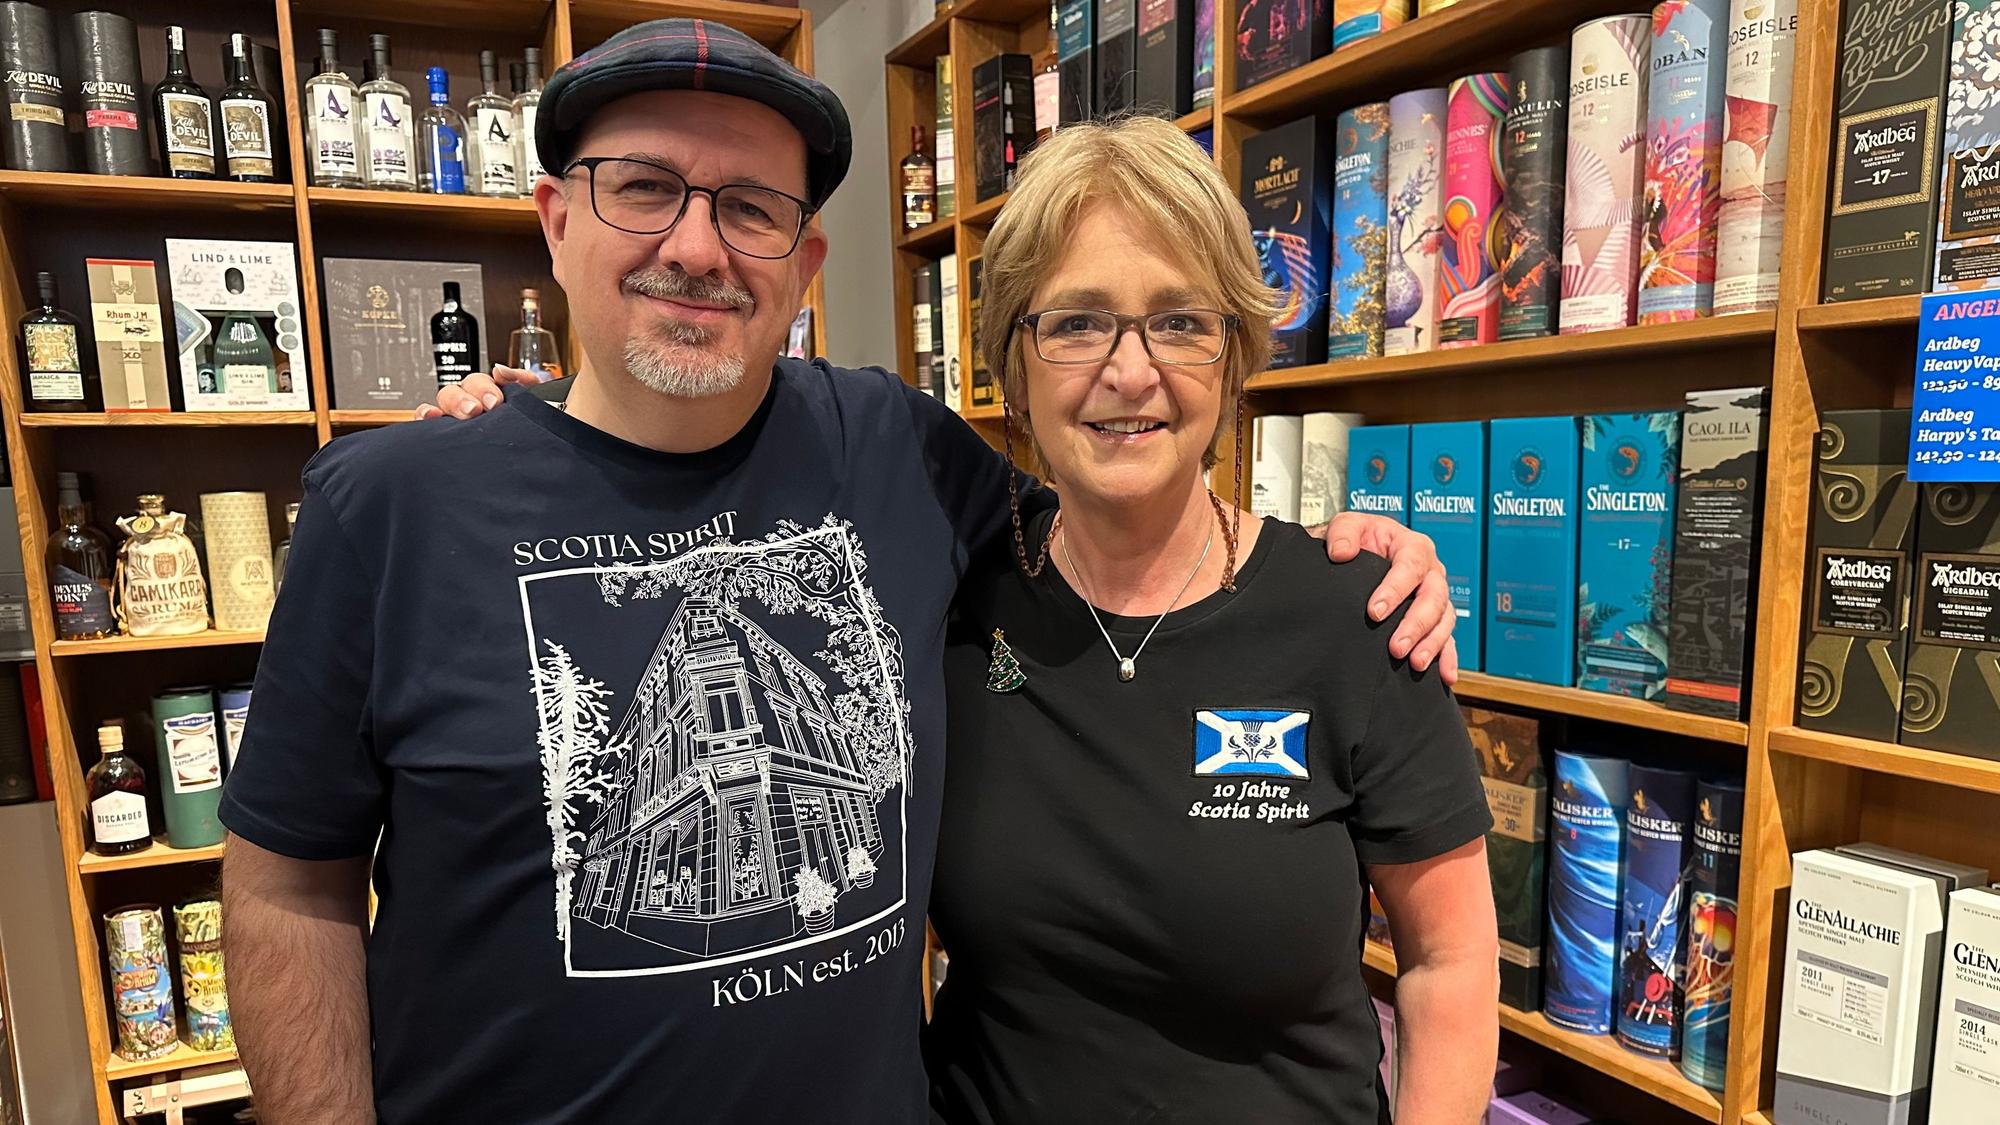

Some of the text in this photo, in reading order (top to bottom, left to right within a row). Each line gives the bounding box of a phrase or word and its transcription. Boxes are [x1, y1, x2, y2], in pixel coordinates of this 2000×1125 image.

[1653, 47, 1707, 71] OBAN
[1745, 51, 1759, 67] 12
[4, 70, 28, 84] Kill
[28, 72, 62, 89] DEVIL
[80, 81, 135, 95] Kill DEVIL
[1583, 103, 1594, 116] 12
[172, 116, 194, 127] Kill
[228, 122, 247, 133] Kill
[176, 126, 208, 139] DEVIL
[230, 131, 262, 142] DEVIL
[1515, 130, 1525, 144] 12
[1254, 168, 1301, 193] MORTLACH
[1872, 169, 1891, 185] 17
[1967, 214, 1991, 223] SCOTCH
[192, 253, 224, 263] LIND
[240, 255, 272, 264] LIME
[106, 310, 131, 319] Rhum
[361, 310, 398, 319] KOPKE
[1924, 336, 1981, 352] Ardbeg
[1918, 408, 1974, 424] Ardbeg
[1688, 421, 1751, 437] CAOL ILA
[1917, 427, 1977, 445] Harpy's
[1350, 490, 1403, 512] SINGLETON
[1414, 491, 1476, 514] SINGLETON
[1493, 493, 1566, 518] SINGLETON
[1587, 487, 1668, 513] SINGLETON
[513, 510, 738, 566] SCOTIA SPIRIT
[1618, 538, 1630, 550] 17
[1456, 586, 1470, 595] OLD
[1830, 579, 1884, 589] CORRYVRECKAN
[1943, 586, 1989, 597] UIGEADAIL
[55, 592, 88, 602] POINT
[1496, 592, 1511, 613] 18
[152, 601, 191, 614] RUM
[1212, 780, 1290, 801] 10 Jahre
[1188, 799, 1310, 823] Scotia Spirit
[1553, 797, 1613, 818] TALISKER
[97, 811, 142, 824] DISCARDED
[1703, 853, 1713, 868] 11
[1798, 920, 1865, 945] SPEYSIDE SINGLE MALT
[1798, 926, 1847, 946] SCOTCH WHISKY
[1972, 945, 1984, 953] THE
[712, 917, 906, 1008] KÖLN est. 2013
[1801, 966, 1822, 982] 2011
[1956, 965, 1987, 980] SPEYSIDE
[1956, 973, 1984, 987] SCOTCH
[1801, 977, 1834, 992] SINGLE CASK
[1960, 1018, 1986, 1036] 2014
[1959, 1029, 1998, 1047] SINGLE CASK
